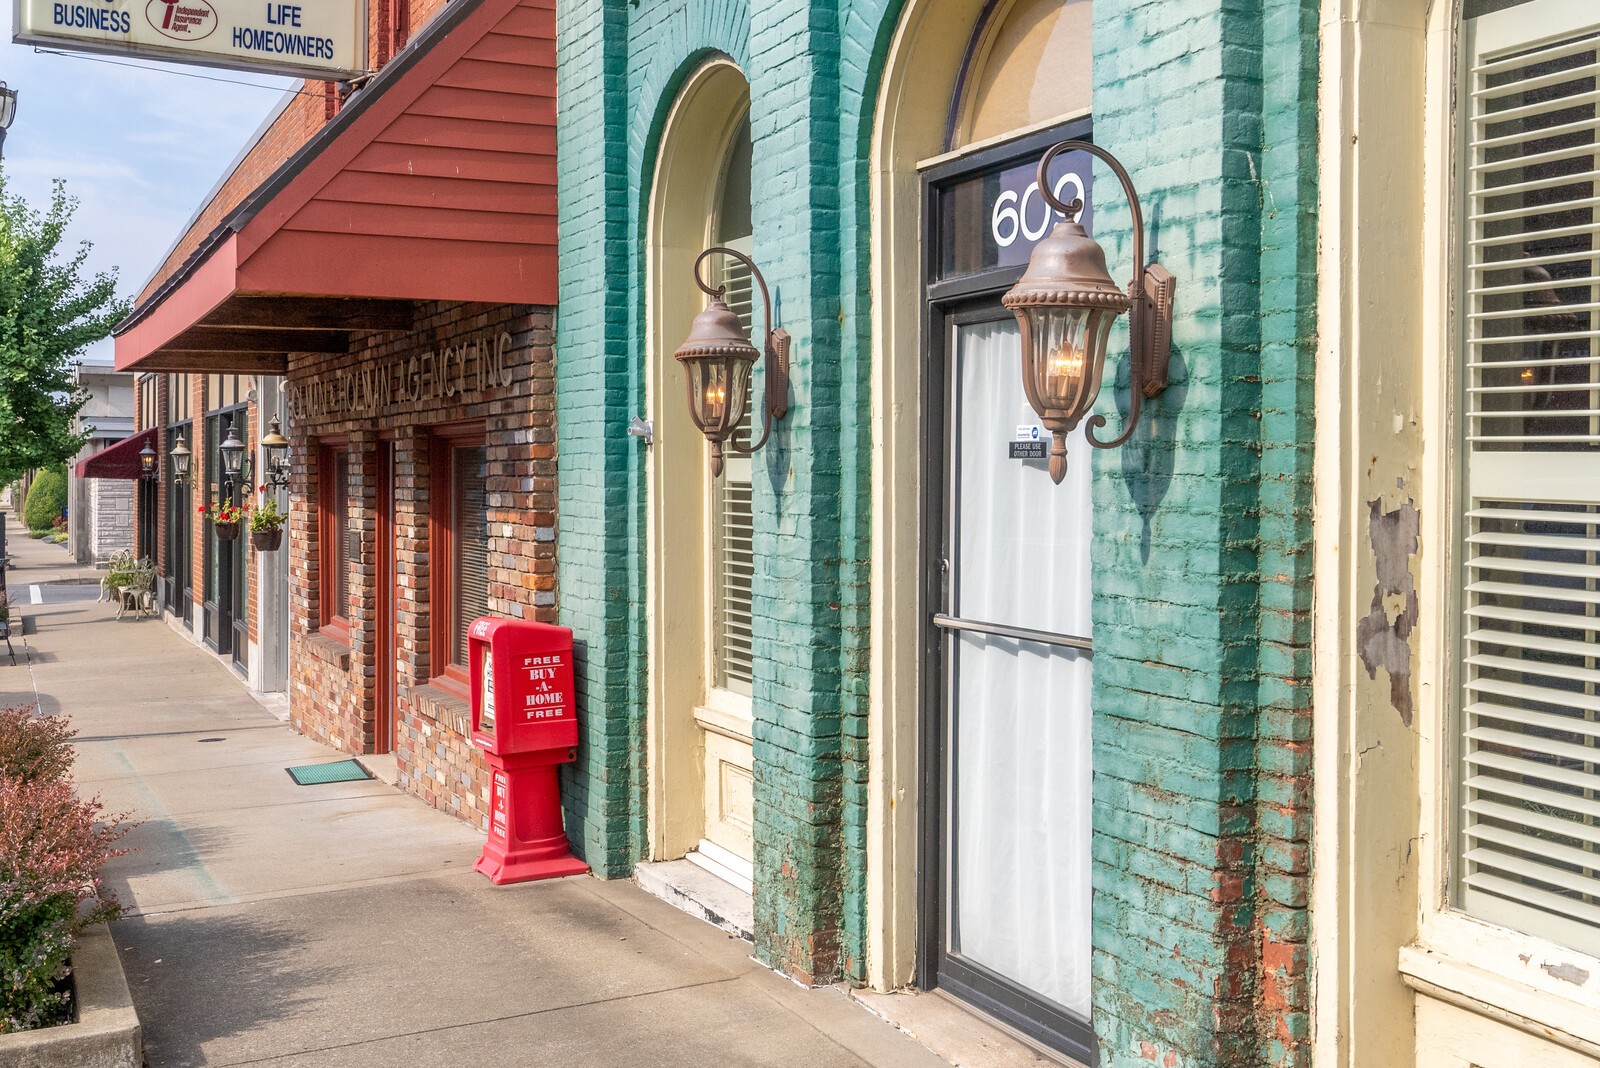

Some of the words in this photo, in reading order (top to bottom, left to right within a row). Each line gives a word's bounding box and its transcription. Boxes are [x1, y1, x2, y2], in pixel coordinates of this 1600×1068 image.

[54, 3, 130, 33] BUSINESS
[176, 6, 210, 18] Independent
[267, 3, 302, 28] LIFE
[174, 14, 202, 25] Insurance
[232, 27, 334, 60] HOMEOWNERS
[992, 172, 1085, 247] 609
[339, 363, 391, 414] HOLMAN
[398, 342, 468, 402] AGENCY
[476, 331, 513, 391] INC
[524, 655, 561, 666] FREE
[529, 668, 557, 680] BUY
[536, 681, 553, 692] -A-
[526, 692, 563, 706] HOME
[527, 708, 563, 719] FREE
[494, 826, 506, 839] FREE
